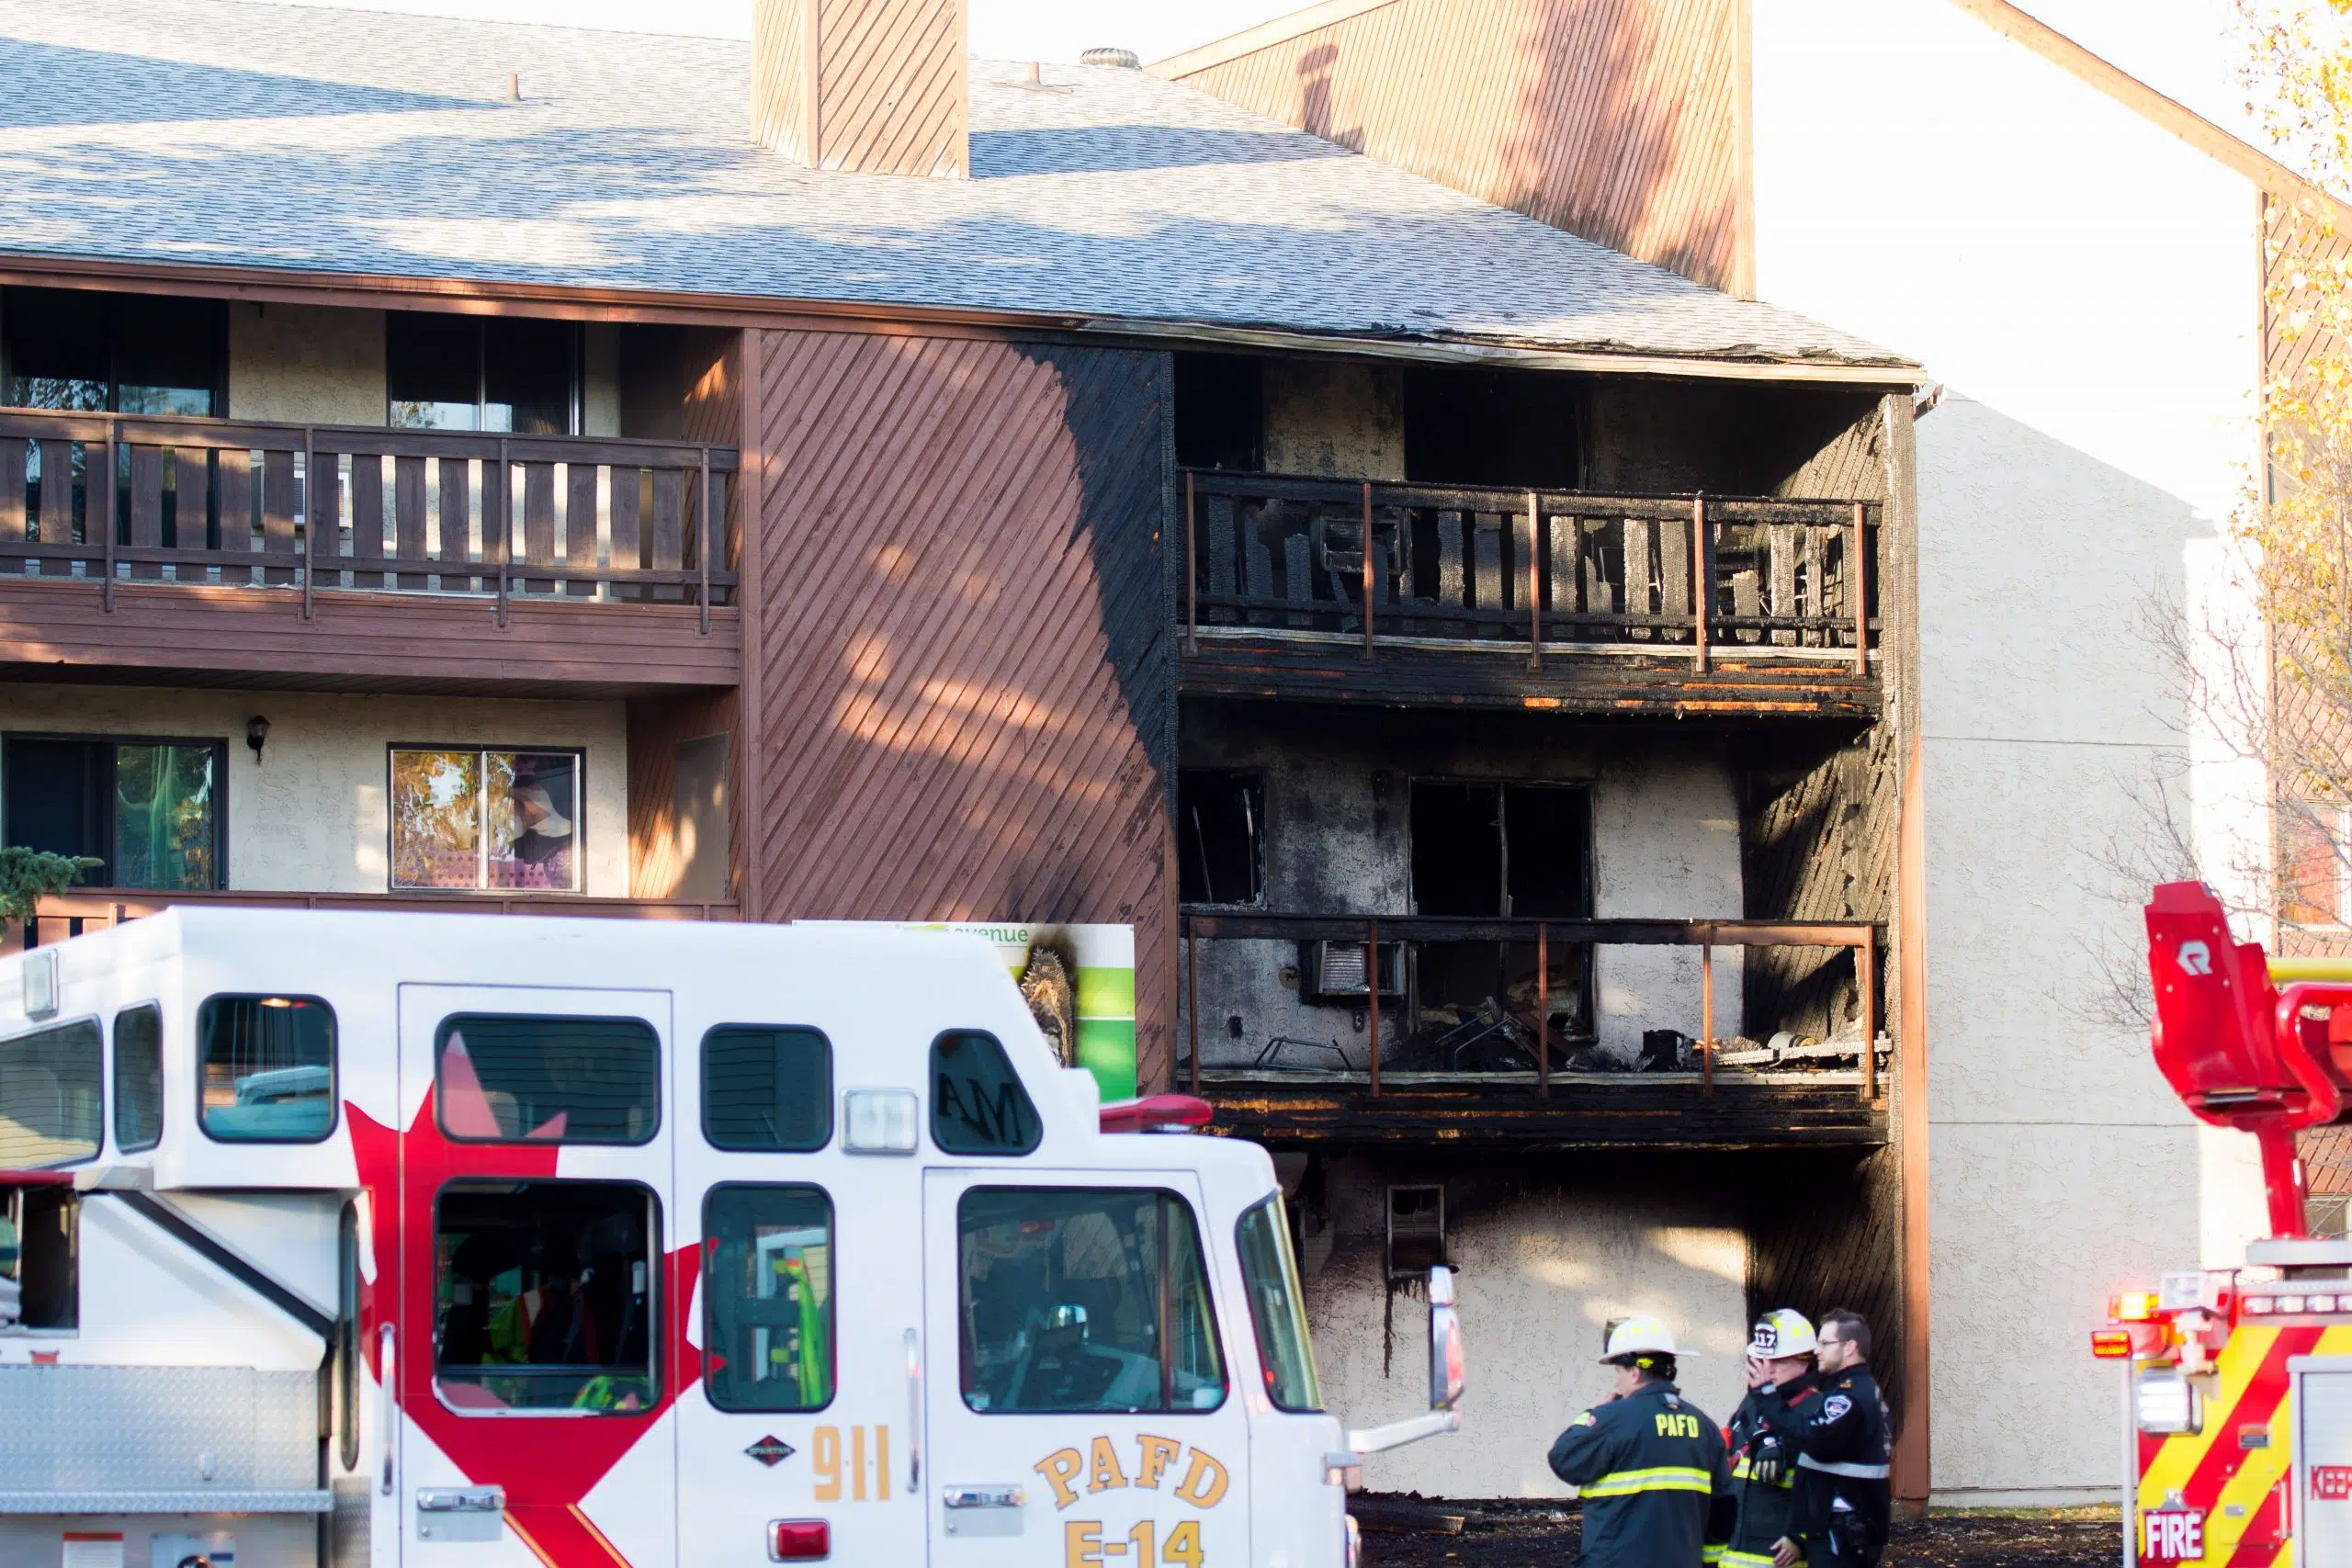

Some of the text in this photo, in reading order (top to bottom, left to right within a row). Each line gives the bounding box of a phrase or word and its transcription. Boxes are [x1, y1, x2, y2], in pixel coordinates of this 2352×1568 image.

[1755, 1332, 1776, 1348] 117
[1655, 1413, 1699, 1438] PAFD
[814, 1425, 890, 1502] 911
[1034, 1433, 1229, 1511] PAFD
[1064, 1519, 1205, 1568] E-14
[2145, 1513, 2202, 1560] FIRE
